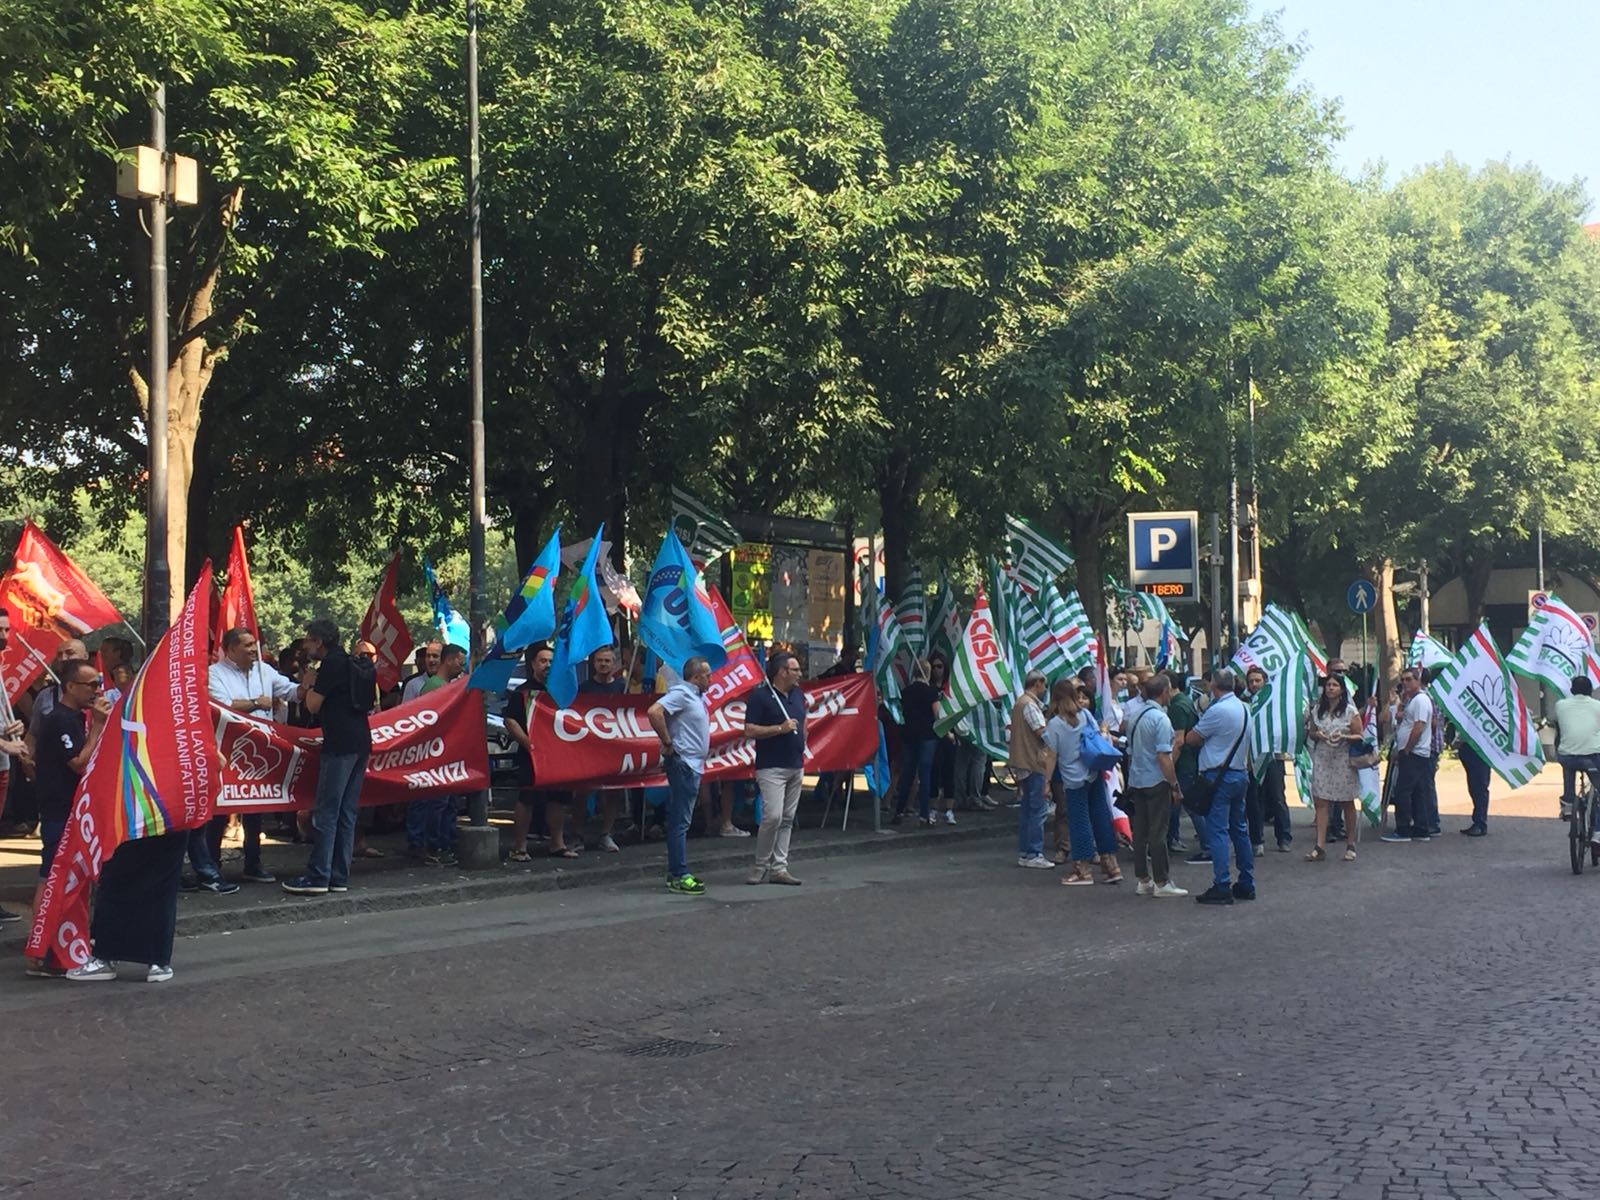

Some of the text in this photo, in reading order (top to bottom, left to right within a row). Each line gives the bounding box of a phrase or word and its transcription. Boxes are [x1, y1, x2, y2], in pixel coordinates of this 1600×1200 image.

[1150, 527, 1177, 563] P
[1248, 634, 1283, 678] CIS
[184, 664, 201, 724] ITALIANA
[370, 710, 439, 744] ERCIO
[554, 707, 659, 742] CGIL
[191, 731, 209, 820] LAVORATORI
[223, 784, 282, 799] FILCAMS
[403, 761, 469, 789] SERVIZI
[31, 864, 62, 949] LAVORATORI
